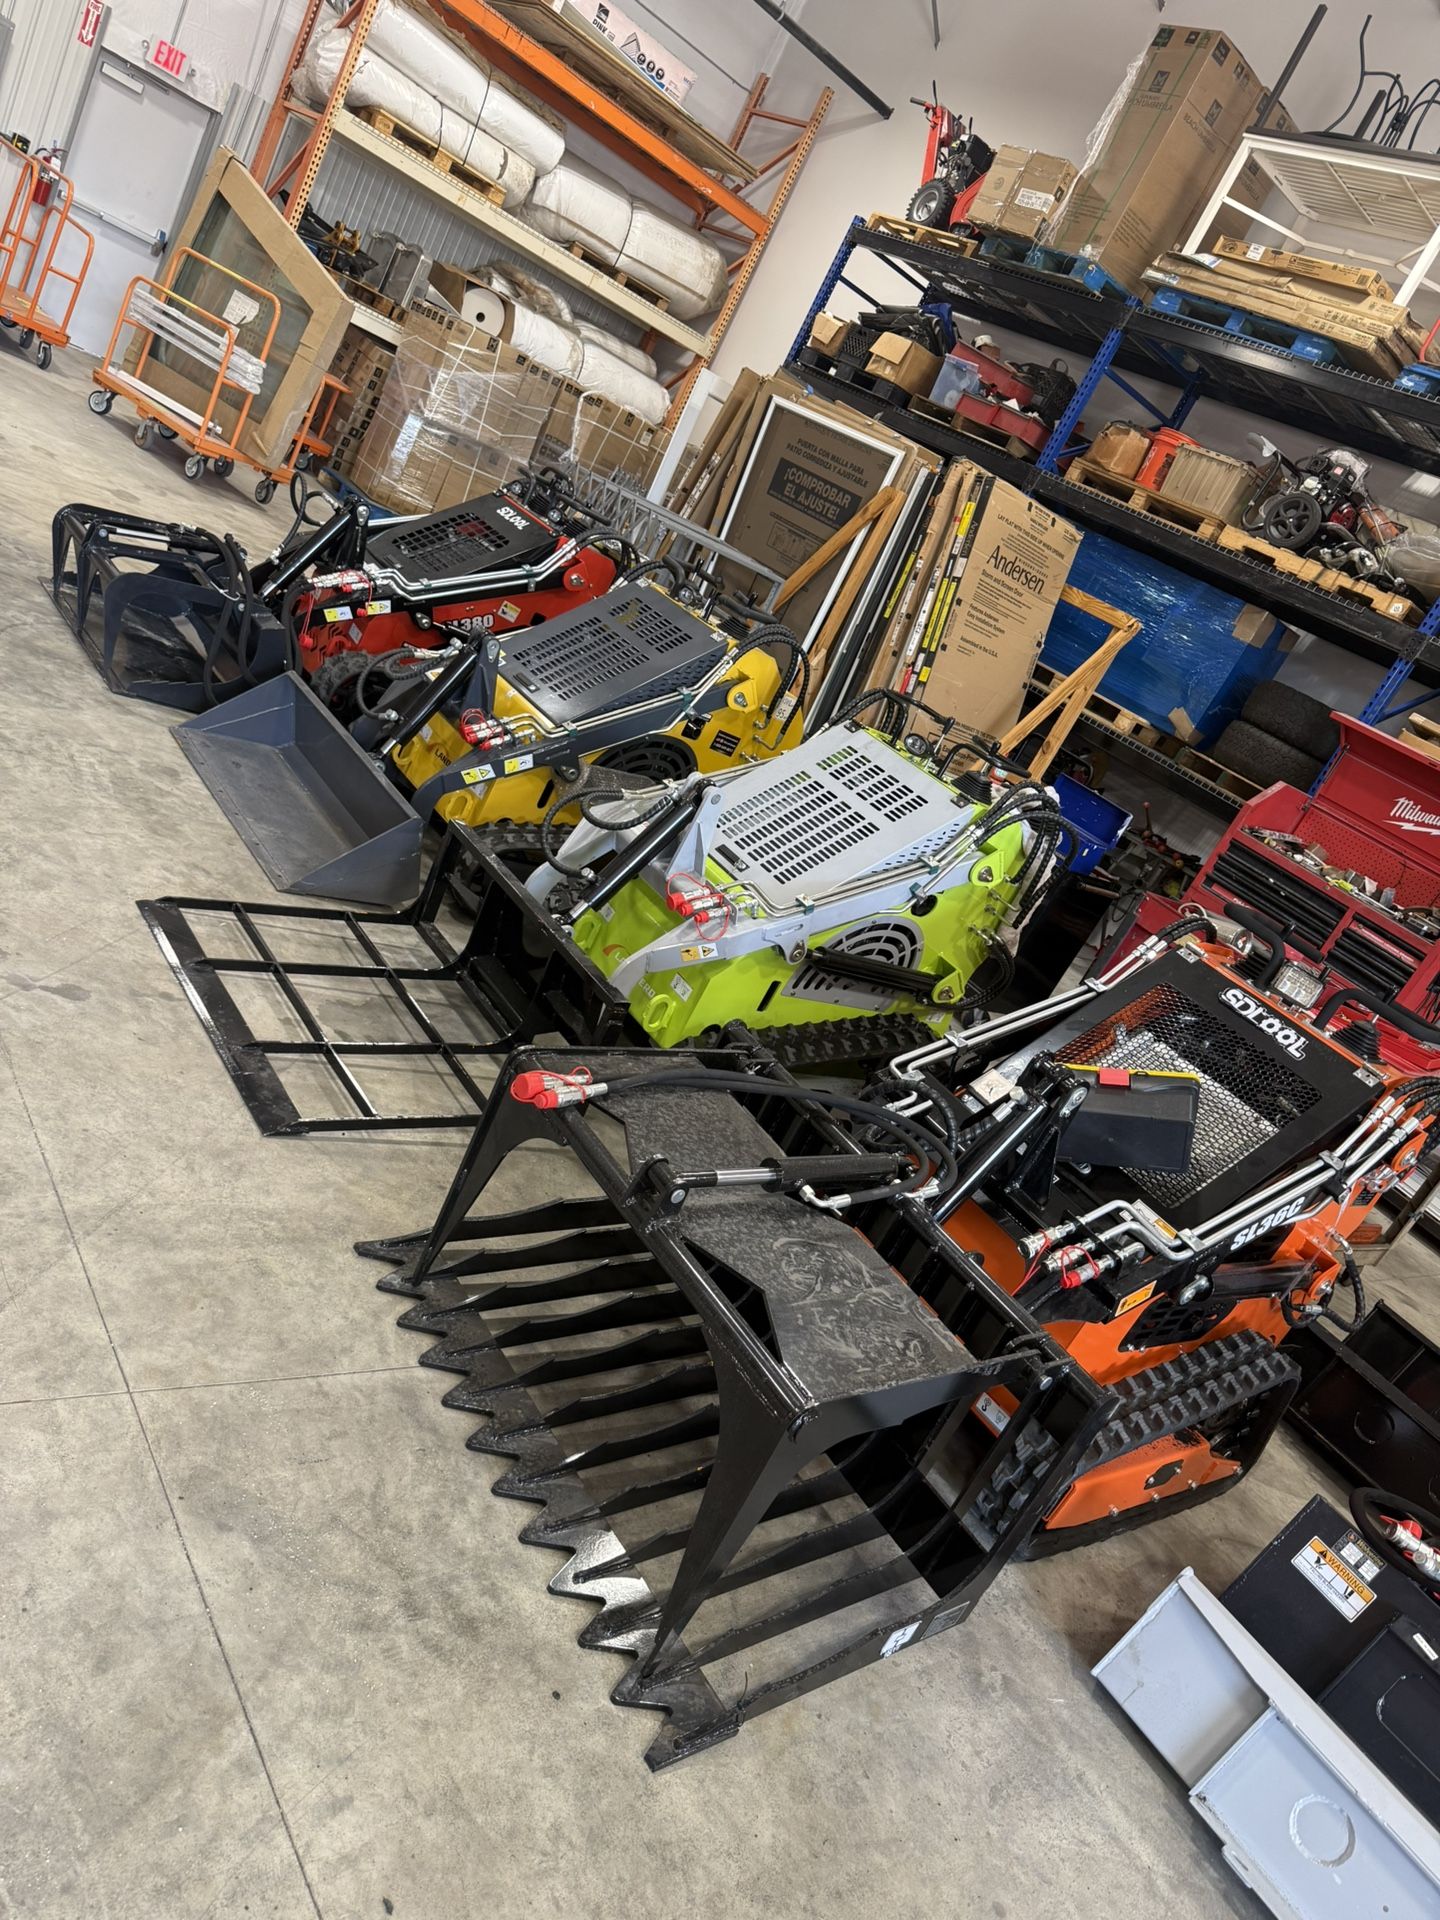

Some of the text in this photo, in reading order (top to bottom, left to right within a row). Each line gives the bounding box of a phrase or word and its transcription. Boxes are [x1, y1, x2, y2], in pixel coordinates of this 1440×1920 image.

[153, 39, 187, 77] EXIT
[784, 467, 851, 509] ¡COMPROBAR
[784, 483, 799, 498] EL
[798, 490, 839, 520] AJUSTE!
[986, 544, 1045, 596] Andersen
[1327, 1555, 1365, 1594] WARNING
